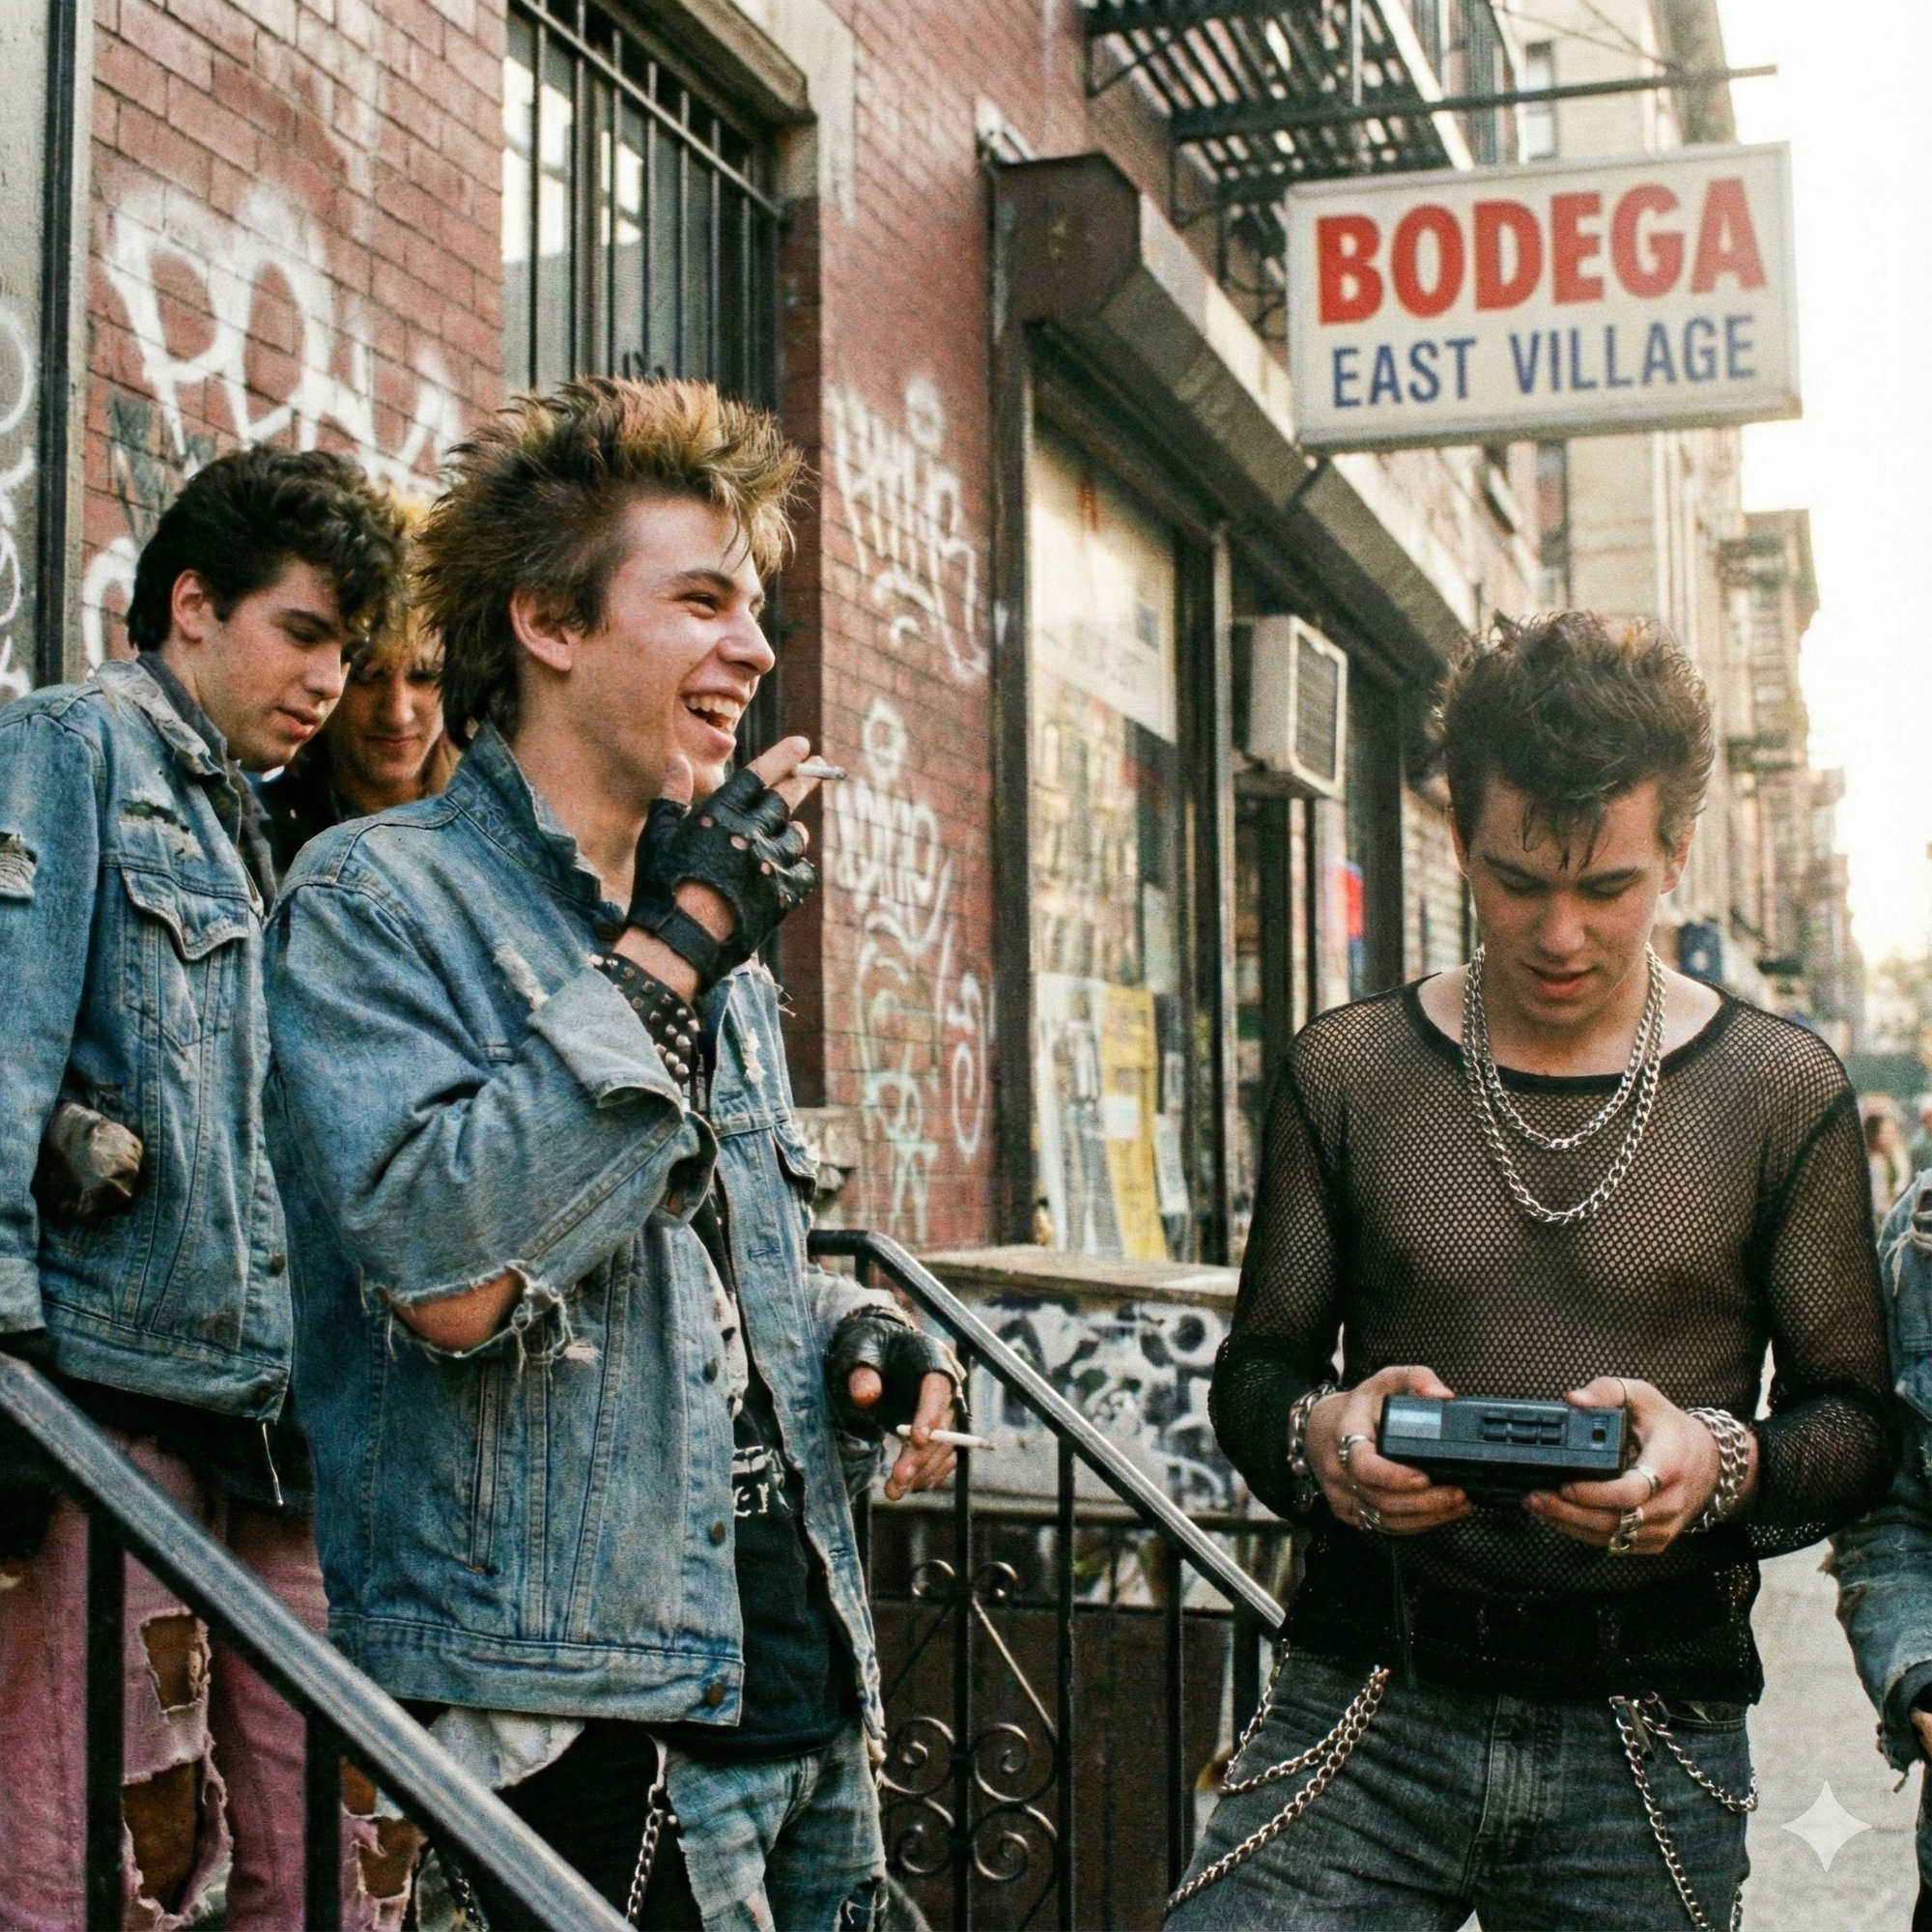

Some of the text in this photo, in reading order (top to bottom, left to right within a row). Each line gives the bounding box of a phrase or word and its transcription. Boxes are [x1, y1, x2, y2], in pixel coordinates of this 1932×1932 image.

[1317, 177, 1768, 327] BODEGA
[1332, 314, 1756, 409] EAST VILLAGE
